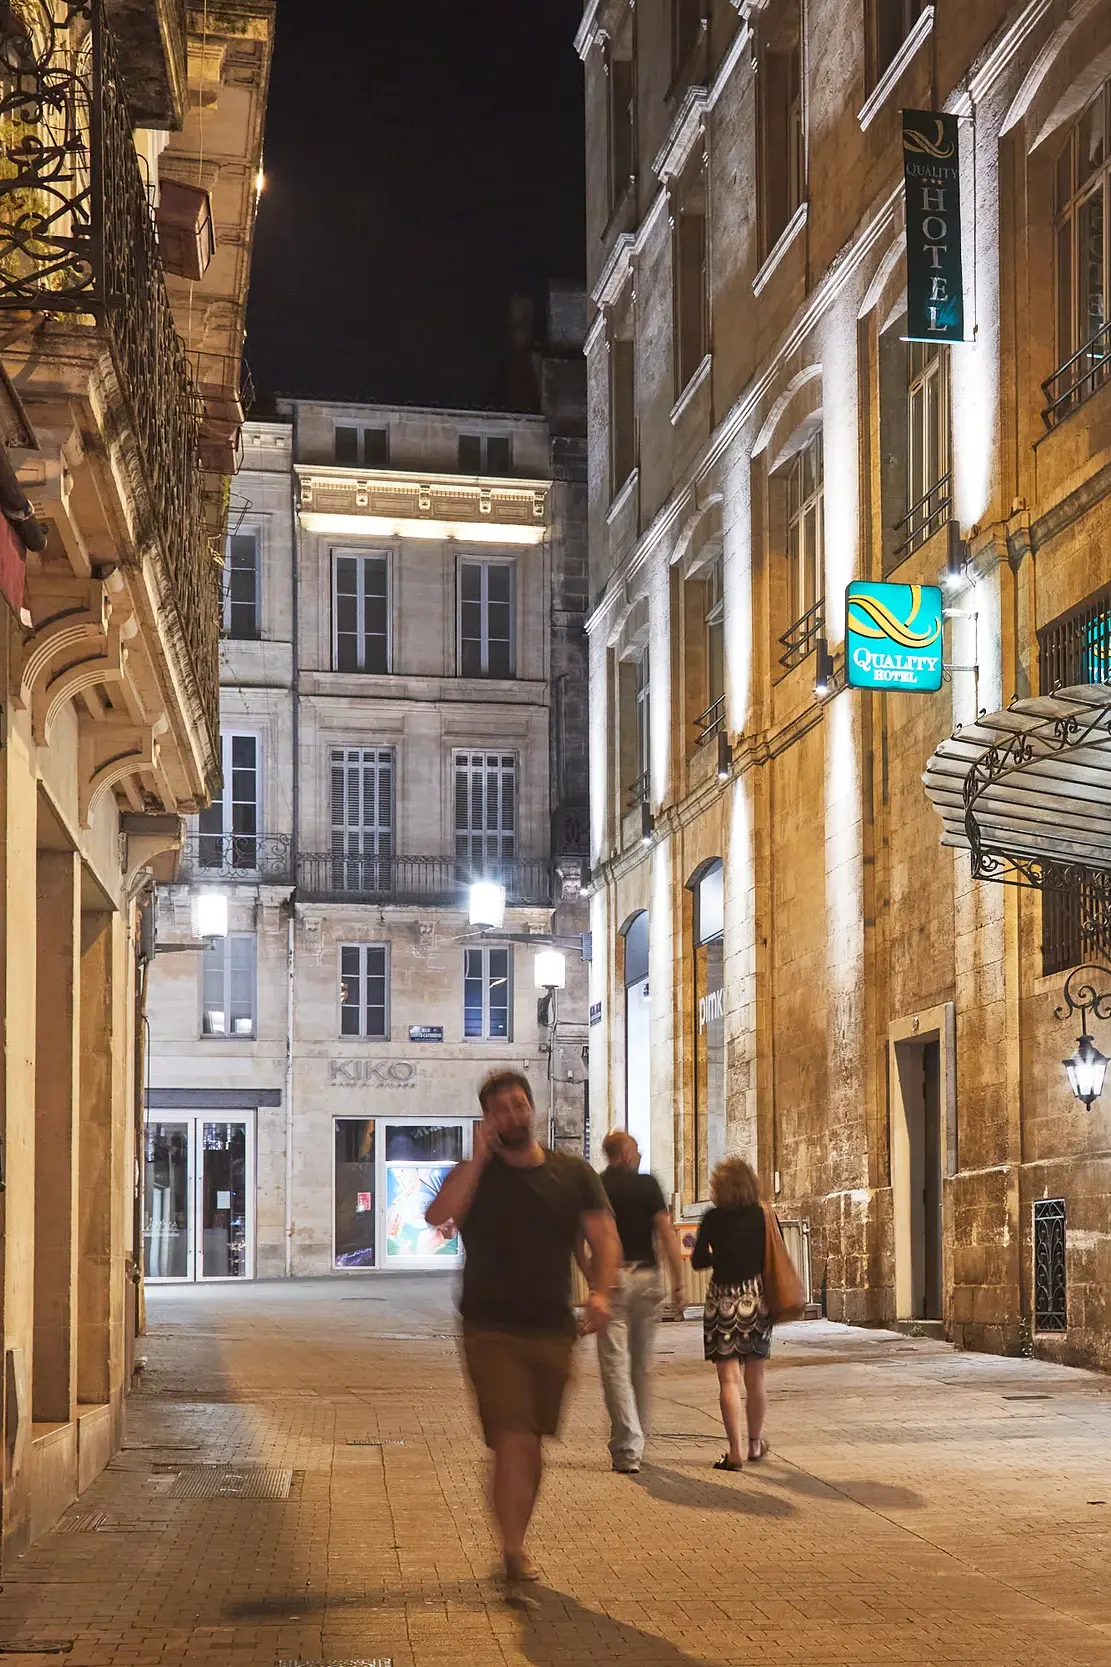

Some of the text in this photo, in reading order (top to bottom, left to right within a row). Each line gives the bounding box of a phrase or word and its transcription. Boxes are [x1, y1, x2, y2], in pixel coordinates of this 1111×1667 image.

[906, 162, 958, 179] QUALITY
[921, 187, 949, 332] HOTEL
[853, 647, 939, 672] QUALITY
[873, 669, 918, 683] HOTEL
[329, 1060, 417, 1081] KIKO
